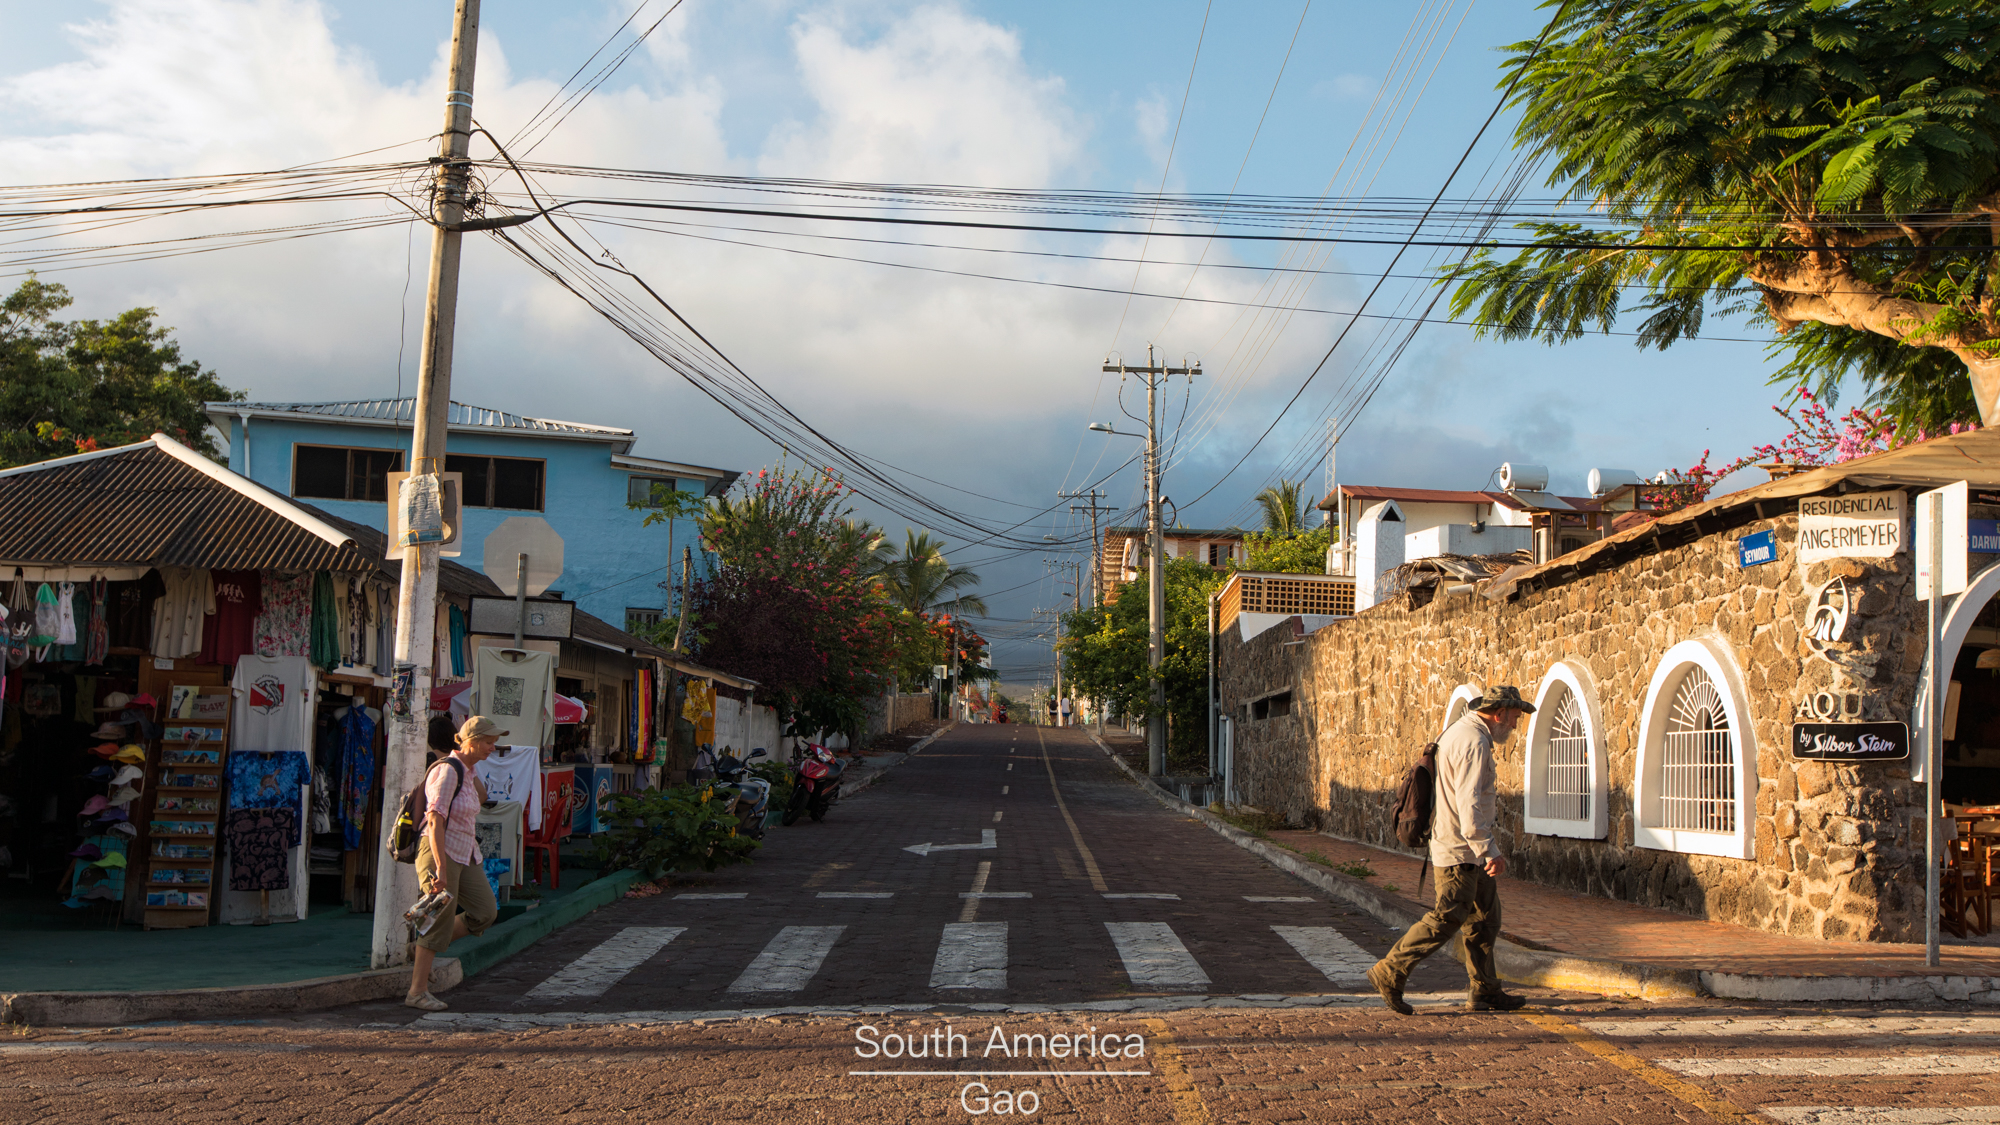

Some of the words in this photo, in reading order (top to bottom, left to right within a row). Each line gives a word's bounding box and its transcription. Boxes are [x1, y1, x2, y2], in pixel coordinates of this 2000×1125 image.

[1800, 523, 1898, 550] ANGERMEYER
[1744, 545, 1770, 564] SEYMOUR
[199, 701, 226, 712] RAW
[1796, 691, 1897, 723] AQUA
[1799, 727, 1813, 747] by
[1804, 733, 1856, 753] Silber
[1846, 733, 1896, 753] Stein
